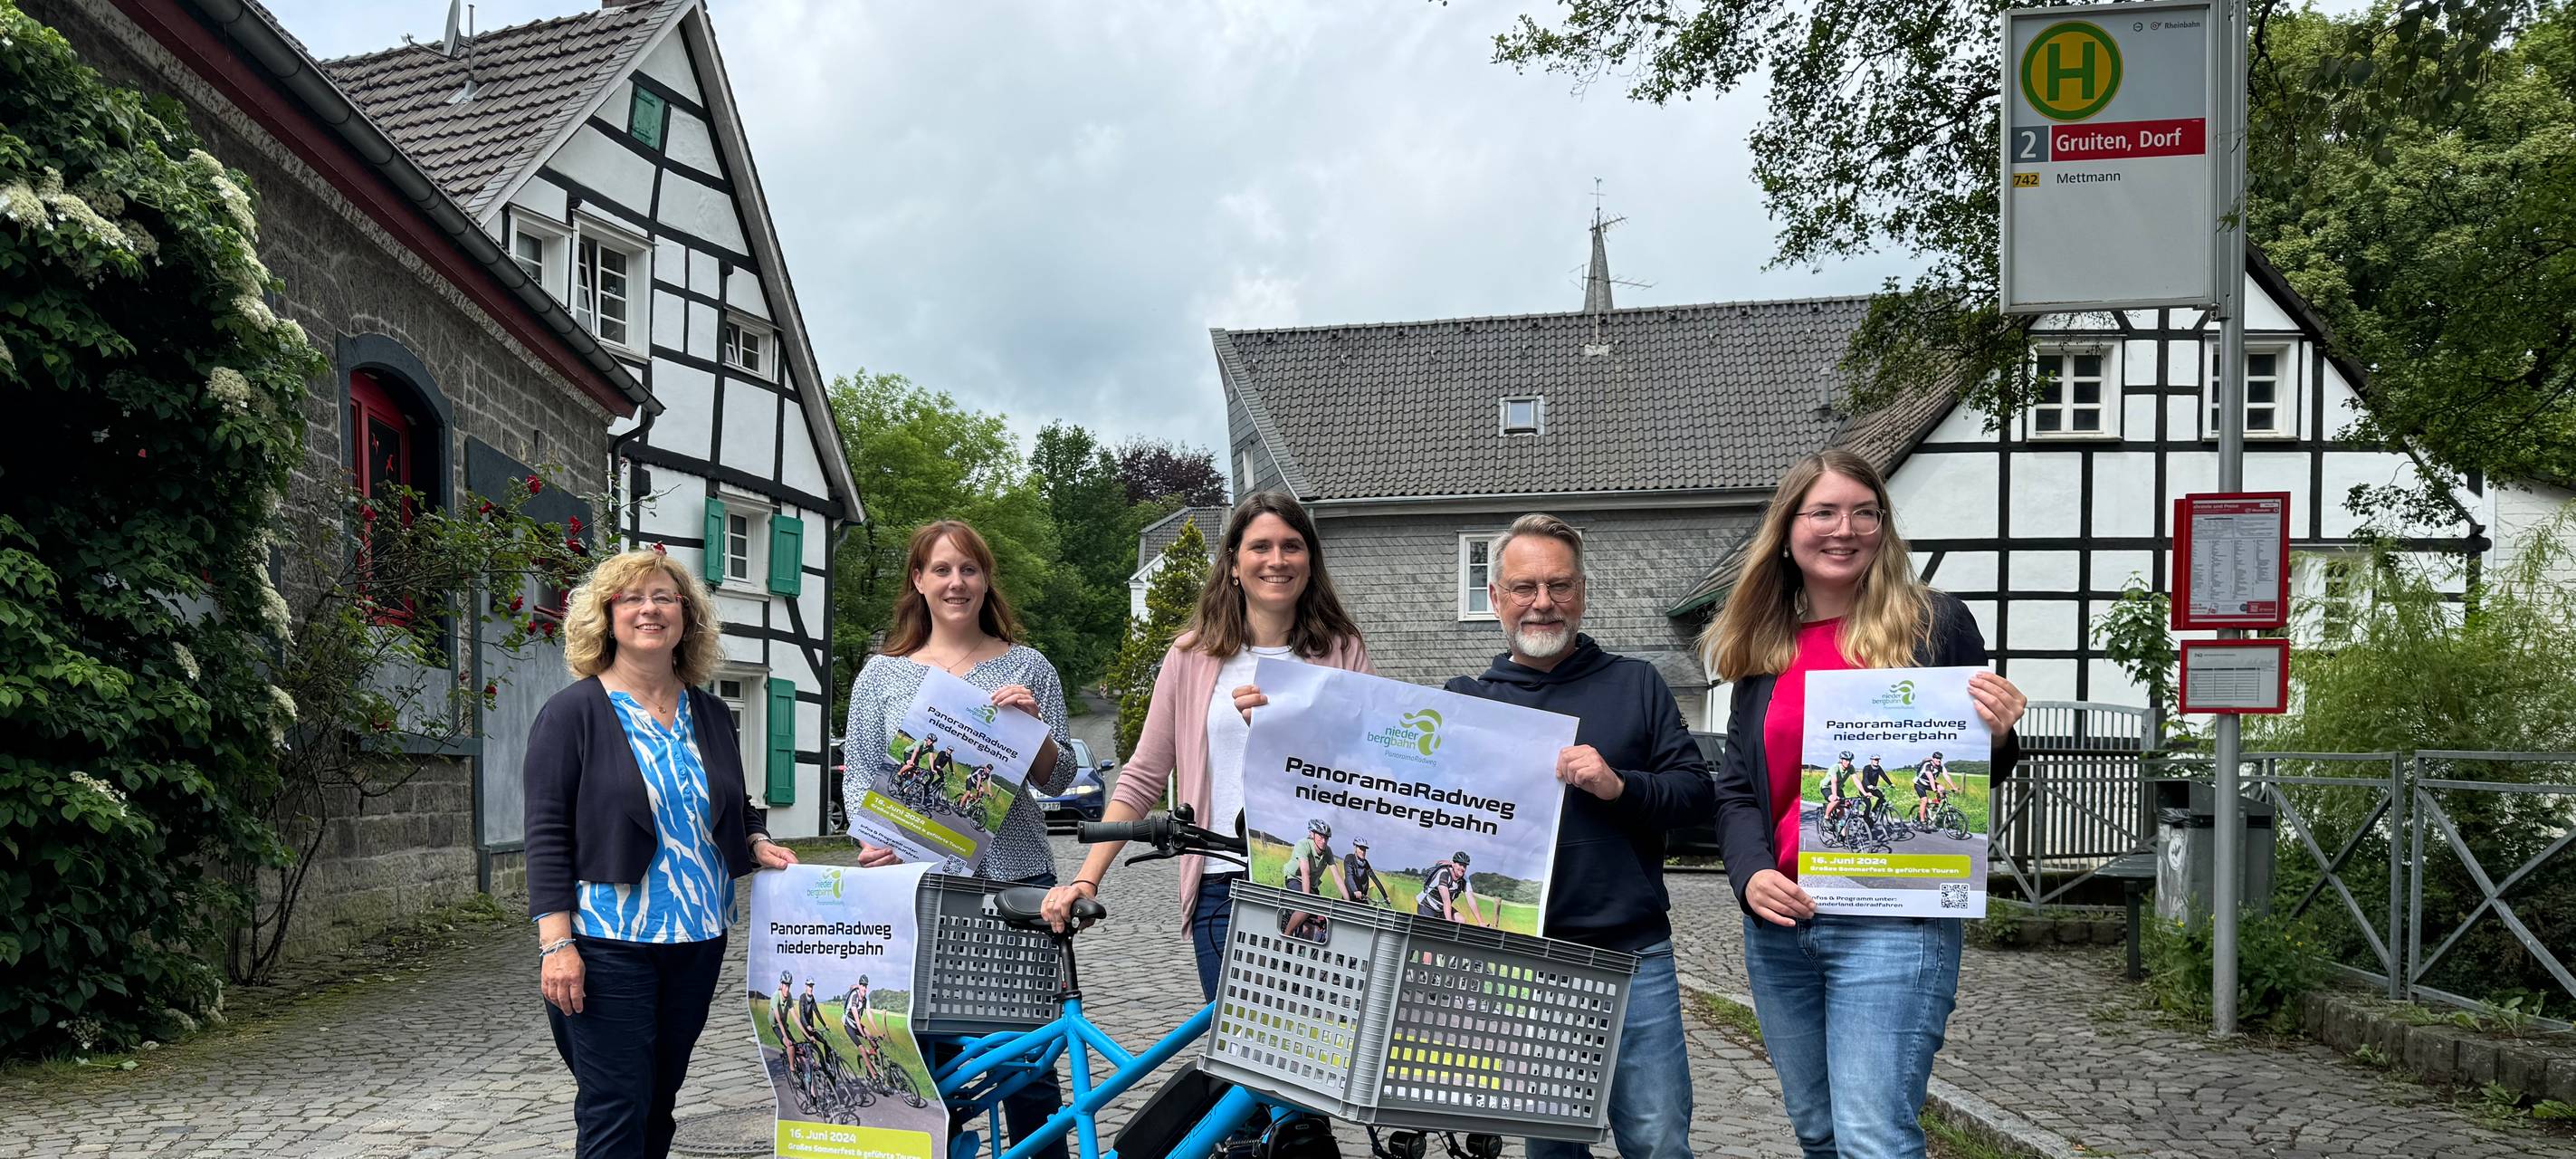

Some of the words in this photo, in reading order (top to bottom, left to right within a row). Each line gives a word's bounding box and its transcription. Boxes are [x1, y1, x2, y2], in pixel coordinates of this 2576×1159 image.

[2046, 41, 2095, 101] H
[2019, 130, 2037, 158] 2
[2056, 132, 2132, 152] Gruiten,
[2139, 128, 2182, 148] Dorf
[2013, 174, 2039, 187] 742
[2056, 172, 2122, 185] Mettmann
[927, 706, 1018, 759] PanoramaRadweg
[1385, 726, 1418, 741] nieder
[1826, 719, 1967, 731] PanoramaRadweg
[929, 718, 1009, 762] niederbergbahn
[1367, 732, 1417, 750] bergbahn
[1834, 731, 1958, 742] niederbergbahn
[1285, 756, 1516, 820] PanoramaRadweg
[887, 804, 904, 815] Juni
[1295, 784, 1498, 835] niederbergbahn
[1811, 857, 1827, 865] 16.
[1829, 857, 1855, 865] Juni
[1856, 857, 1887, 866] 2024
[770, 921, 892, 940] PanoramaRadweg
[777, 940, 883, 959] niederbergbahn
[789, 1128, 805, 1139] 16.
[806, 1130, 827, 1141] Juni
[830, 1132, 856, 1144] 2024
[813, 1145, 855, 1155] Sommerfest
